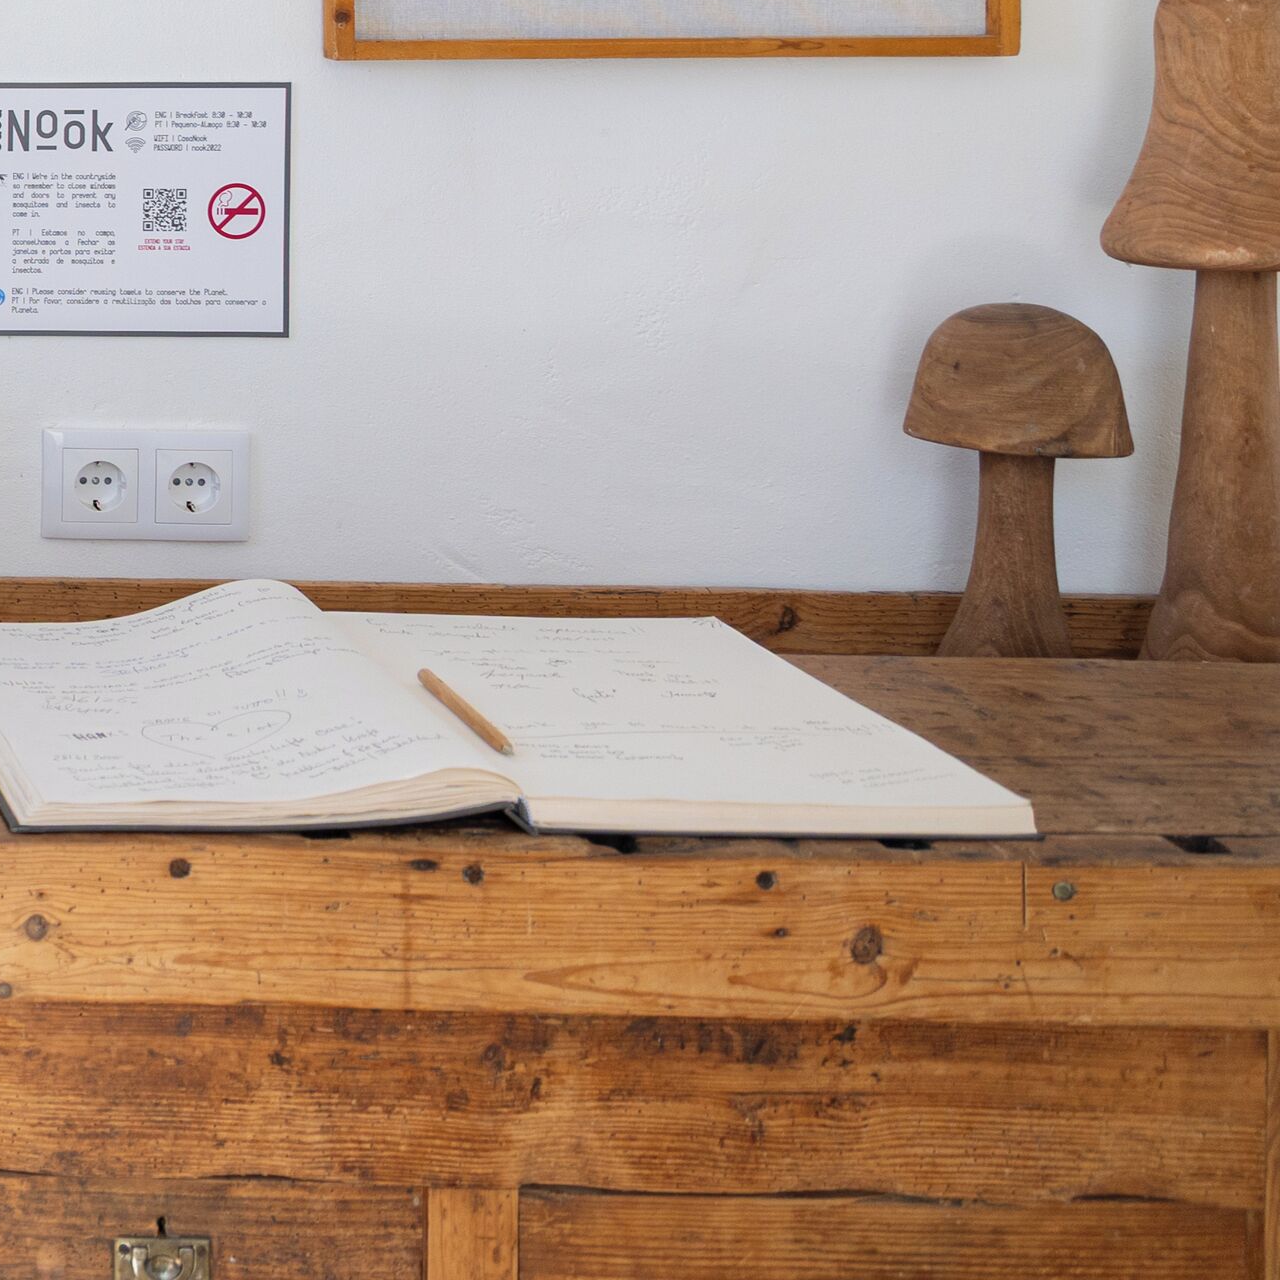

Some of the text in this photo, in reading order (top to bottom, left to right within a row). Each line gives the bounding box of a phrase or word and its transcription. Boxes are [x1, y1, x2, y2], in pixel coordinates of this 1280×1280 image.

[154, 111, 167, 119] ENG
[175, 111, 208, 119] Breakfast
[212, 111, 226, 119] 8:30
[237, 111, 253, 119] 10:30
[171, 120, 223, 129] Pequeno-Almoço
[153, 134, 169, 142] WIFI
[177, 134, 207, 142] CasaNook
[12, 172, 24, 180] ENG
[50, 172, 58, 180] in
[61, 172, 72, 180] the
[75, 172, 116, 181] countryside
[72, 192, 97, 200] prevent
[12, 201, 49, 209] mosquitoes
[12, 248, 38, 256] janelas
[49, 248, 71, 256] portas
[71, 258, 104, 266] mosquitos
[91, 288, 116, 296] reusing
[11, 297, 19, 305] PT
[29, 297, 40, 305] Por
[43, 297, 63, 305] favor,
[66, 297, 100, 305] considere
[111, 298, 156, 306] reutilização
[159, 297, 171, 305] das
[175, 297, 201, 305] toalhas
